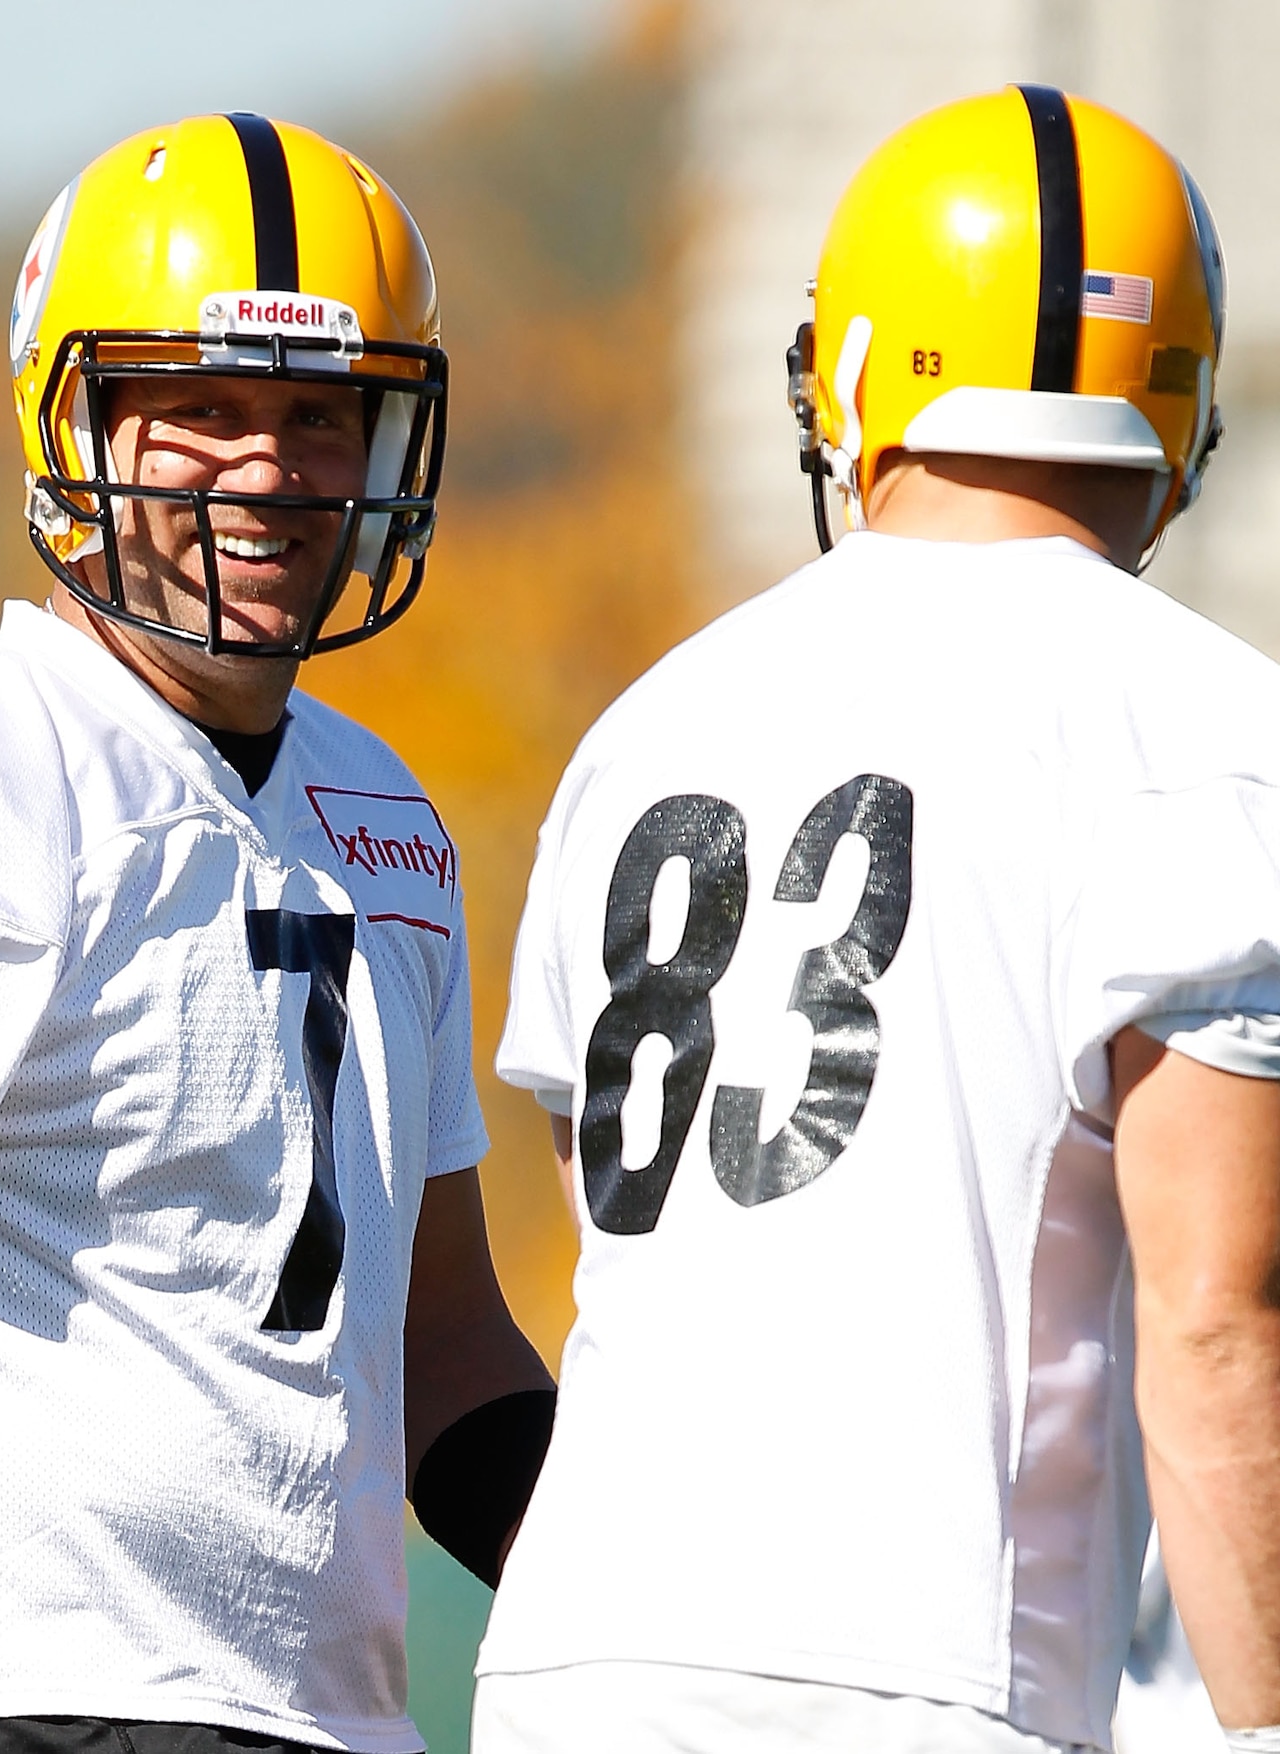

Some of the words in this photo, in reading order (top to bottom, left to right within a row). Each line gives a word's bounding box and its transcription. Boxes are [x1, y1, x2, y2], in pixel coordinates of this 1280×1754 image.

[238, 300, 324, 325] Riddell
[913, 350, 941, 376] 83
[336, 826, 449, 889] xfinity
[580, 774, 914, 1236] 83
[245, 908, 356, 1331] 7
